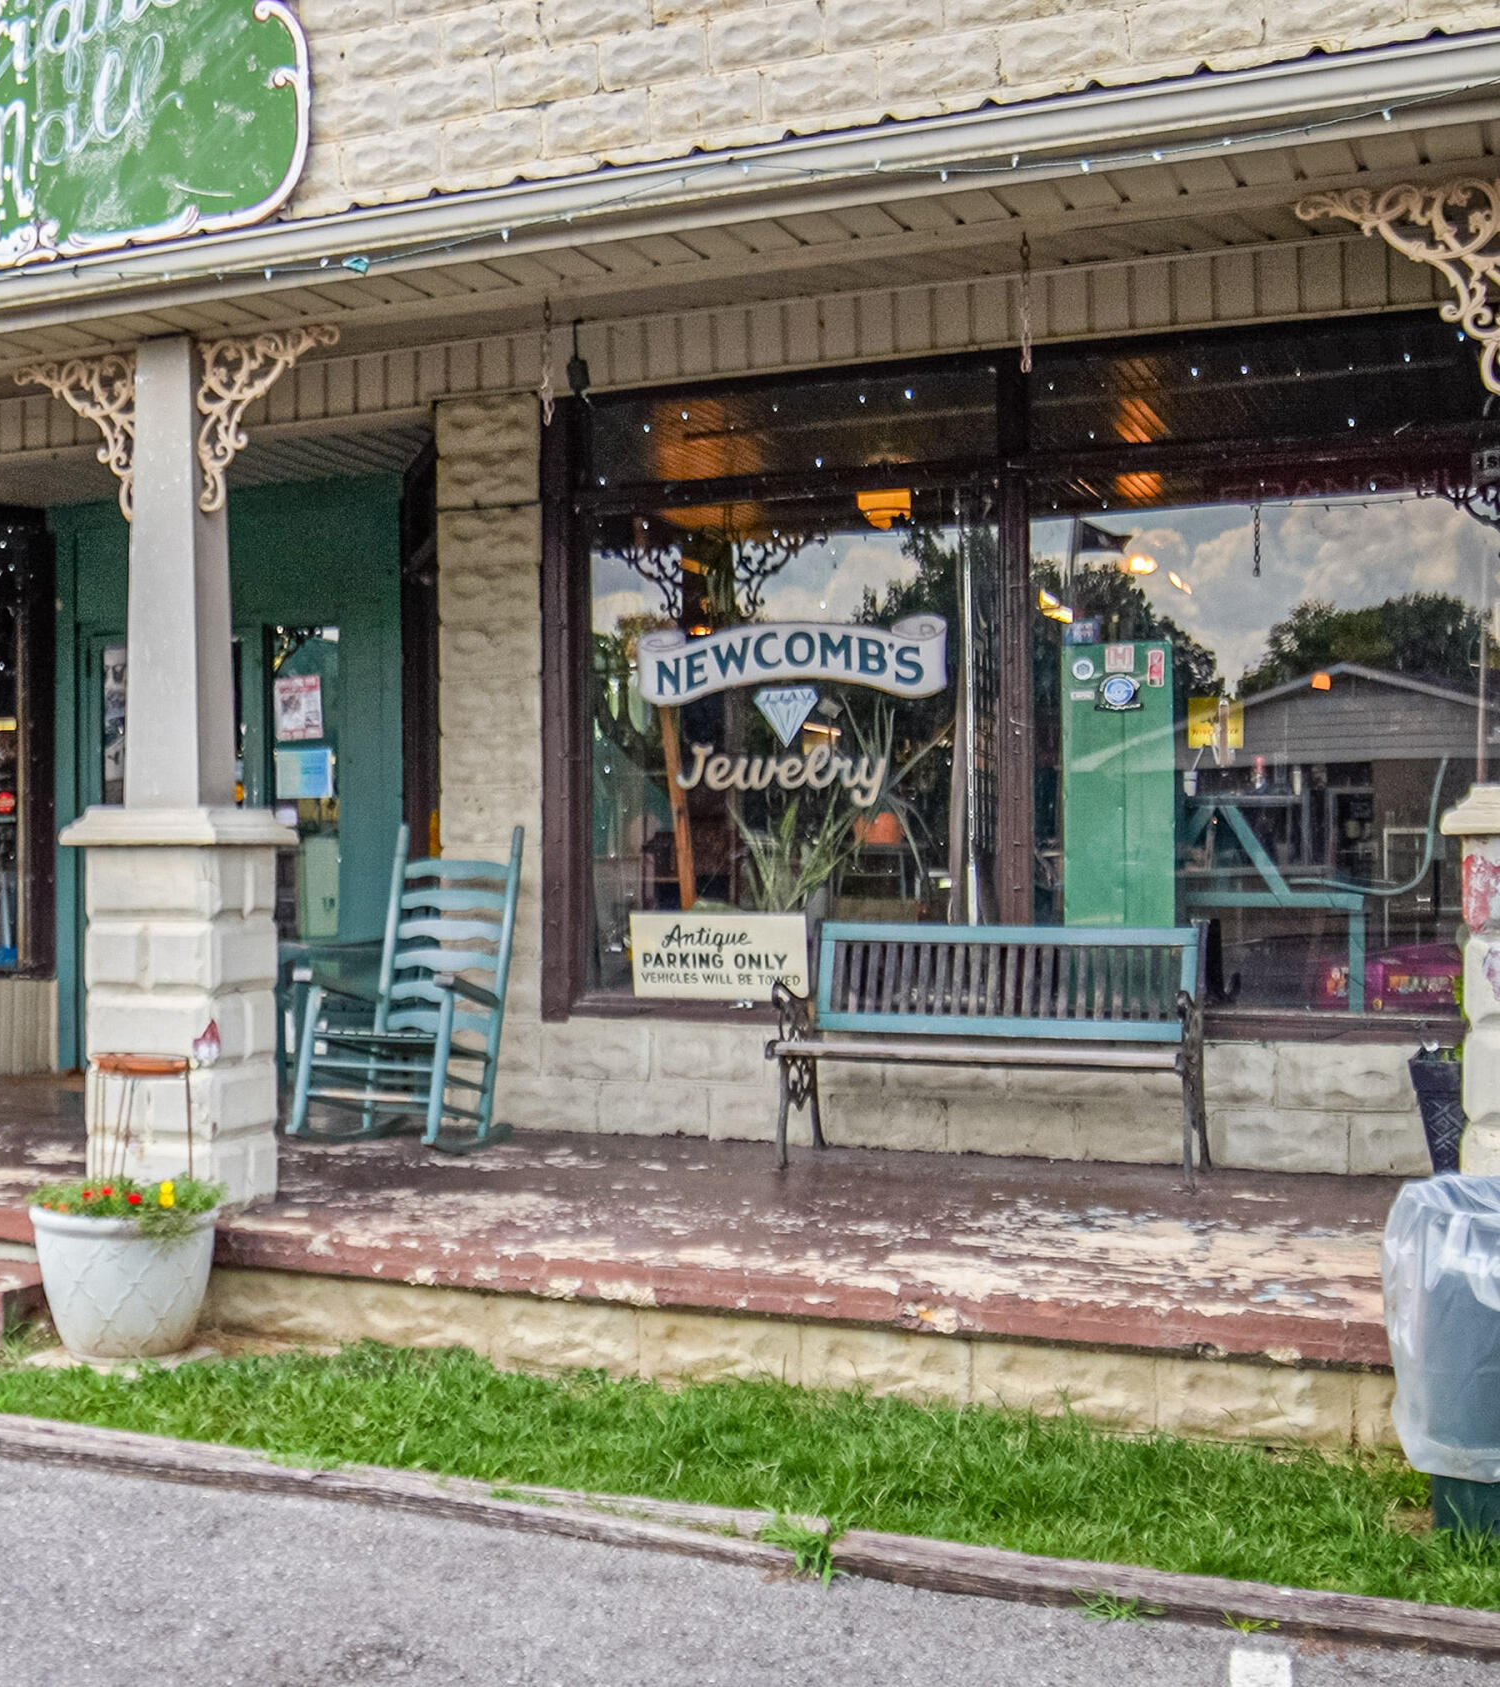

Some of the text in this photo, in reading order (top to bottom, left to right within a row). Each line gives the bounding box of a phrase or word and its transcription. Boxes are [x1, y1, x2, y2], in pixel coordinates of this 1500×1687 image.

[655, 631, 925, 696] NEWCOMB'S
[676, 743, 886, 808] Jewelry
[661, 924, 752, 953] Antique
[642, 953, 788, 971] PARKING ONLY
[641, 972, 801, 987] VEHICLES WILL BE TOWED
